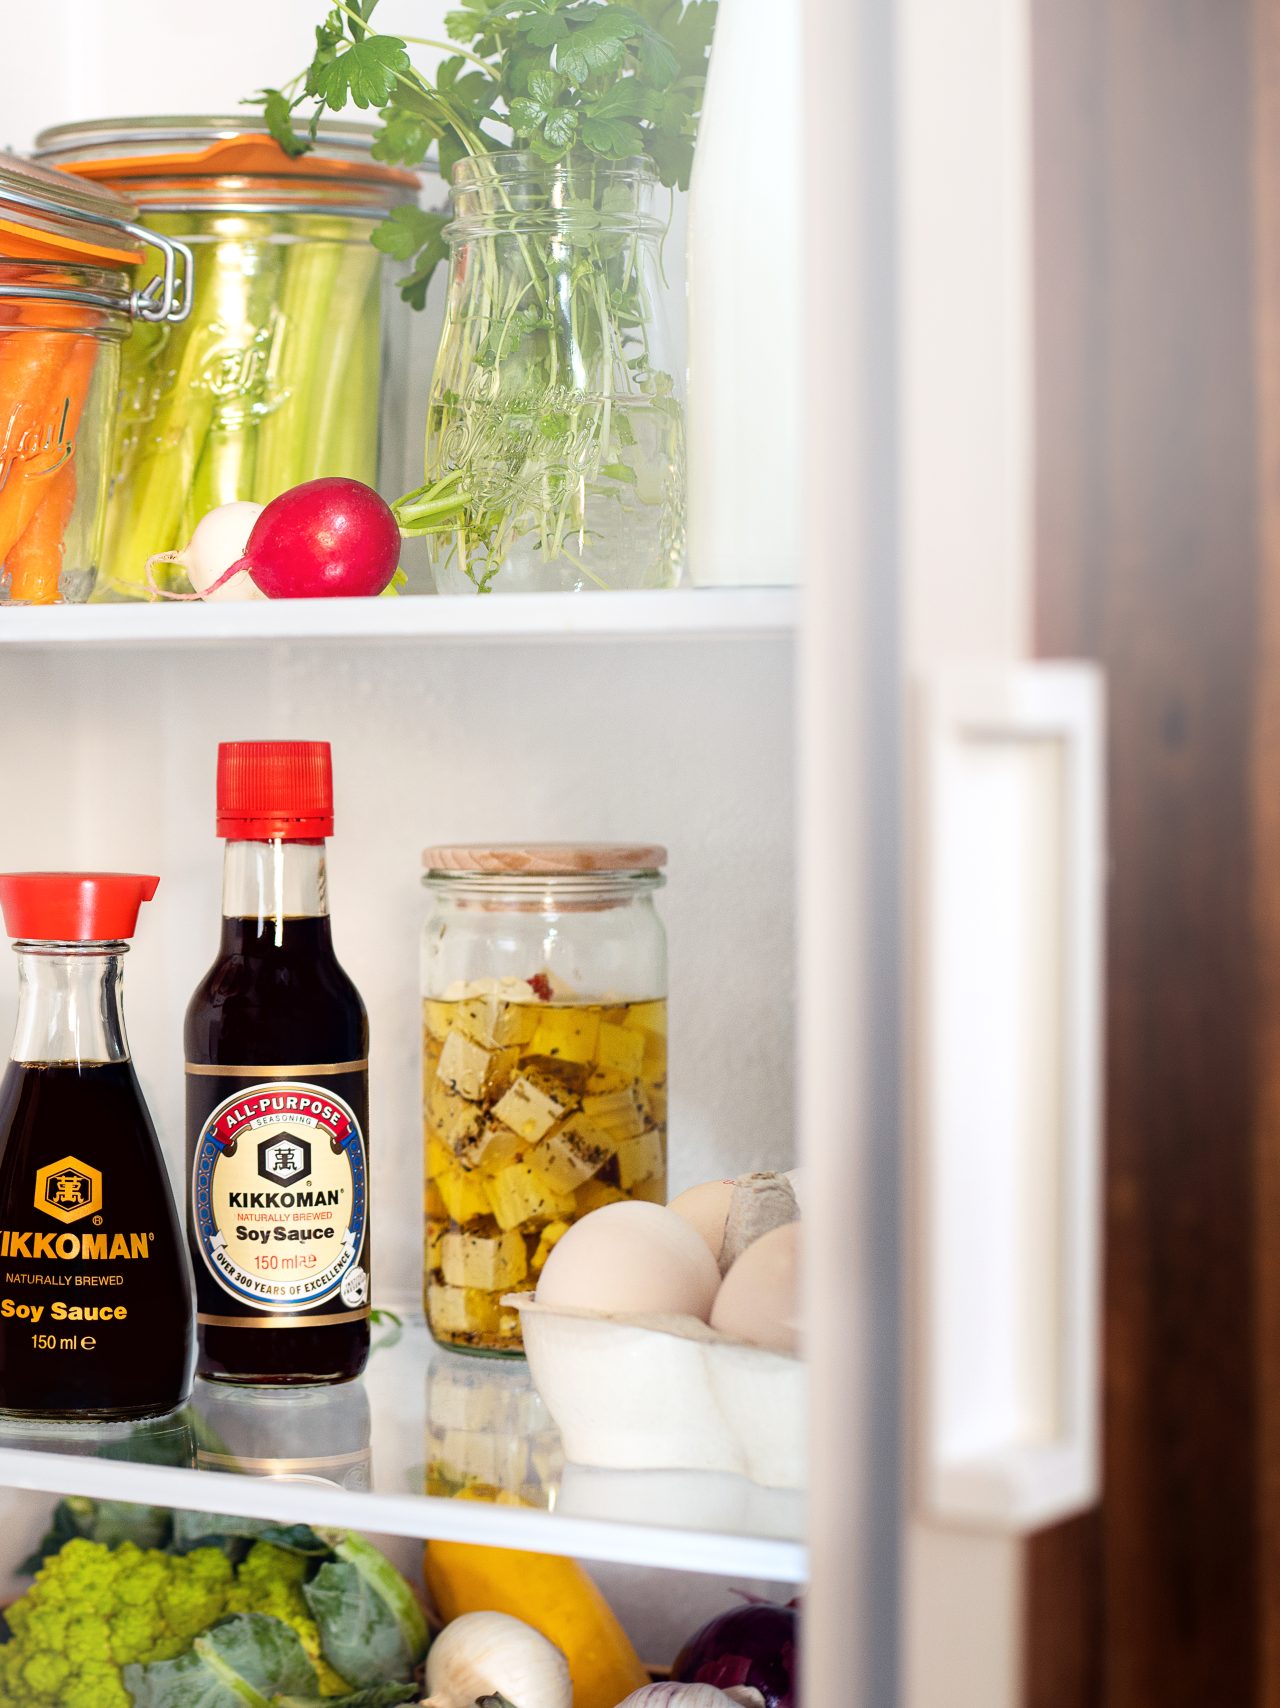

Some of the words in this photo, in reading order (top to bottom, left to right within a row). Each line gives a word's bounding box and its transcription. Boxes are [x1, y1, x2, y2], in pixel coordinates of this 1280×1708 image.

[226, 1096, 341, 1129] ALL-PURPOSE
[256, 1114, 312, 1126] SEASONING
[237, 1212, 290, 1222] NATURALLY
[293, 1211, 333, 1221] BREWED
[235, 1225, 272, 1244] Soy
[273, 1226, 335, 1241] Sauce
[254, 1255, 279, 1270] 150
[5, 1272, 73, 1286] NATURALLY
[74, 1275, 124, 1287] BREWED
[216, 1252, 235, 1277] OVER
[234, 1272, 252, 1288] 300
[254, 1281, 286, 1296] YEARS
[289, 1285, 302, 1296] OF
[305, 1250, 351, 1293] EXCELLENCE
[0, 1299, 45, 1323] Soy
[50, 1301, 128, 1321] Sauce
[31, 1334, 57, 1350] 150
[59, 1335, 77, 1350] ml
